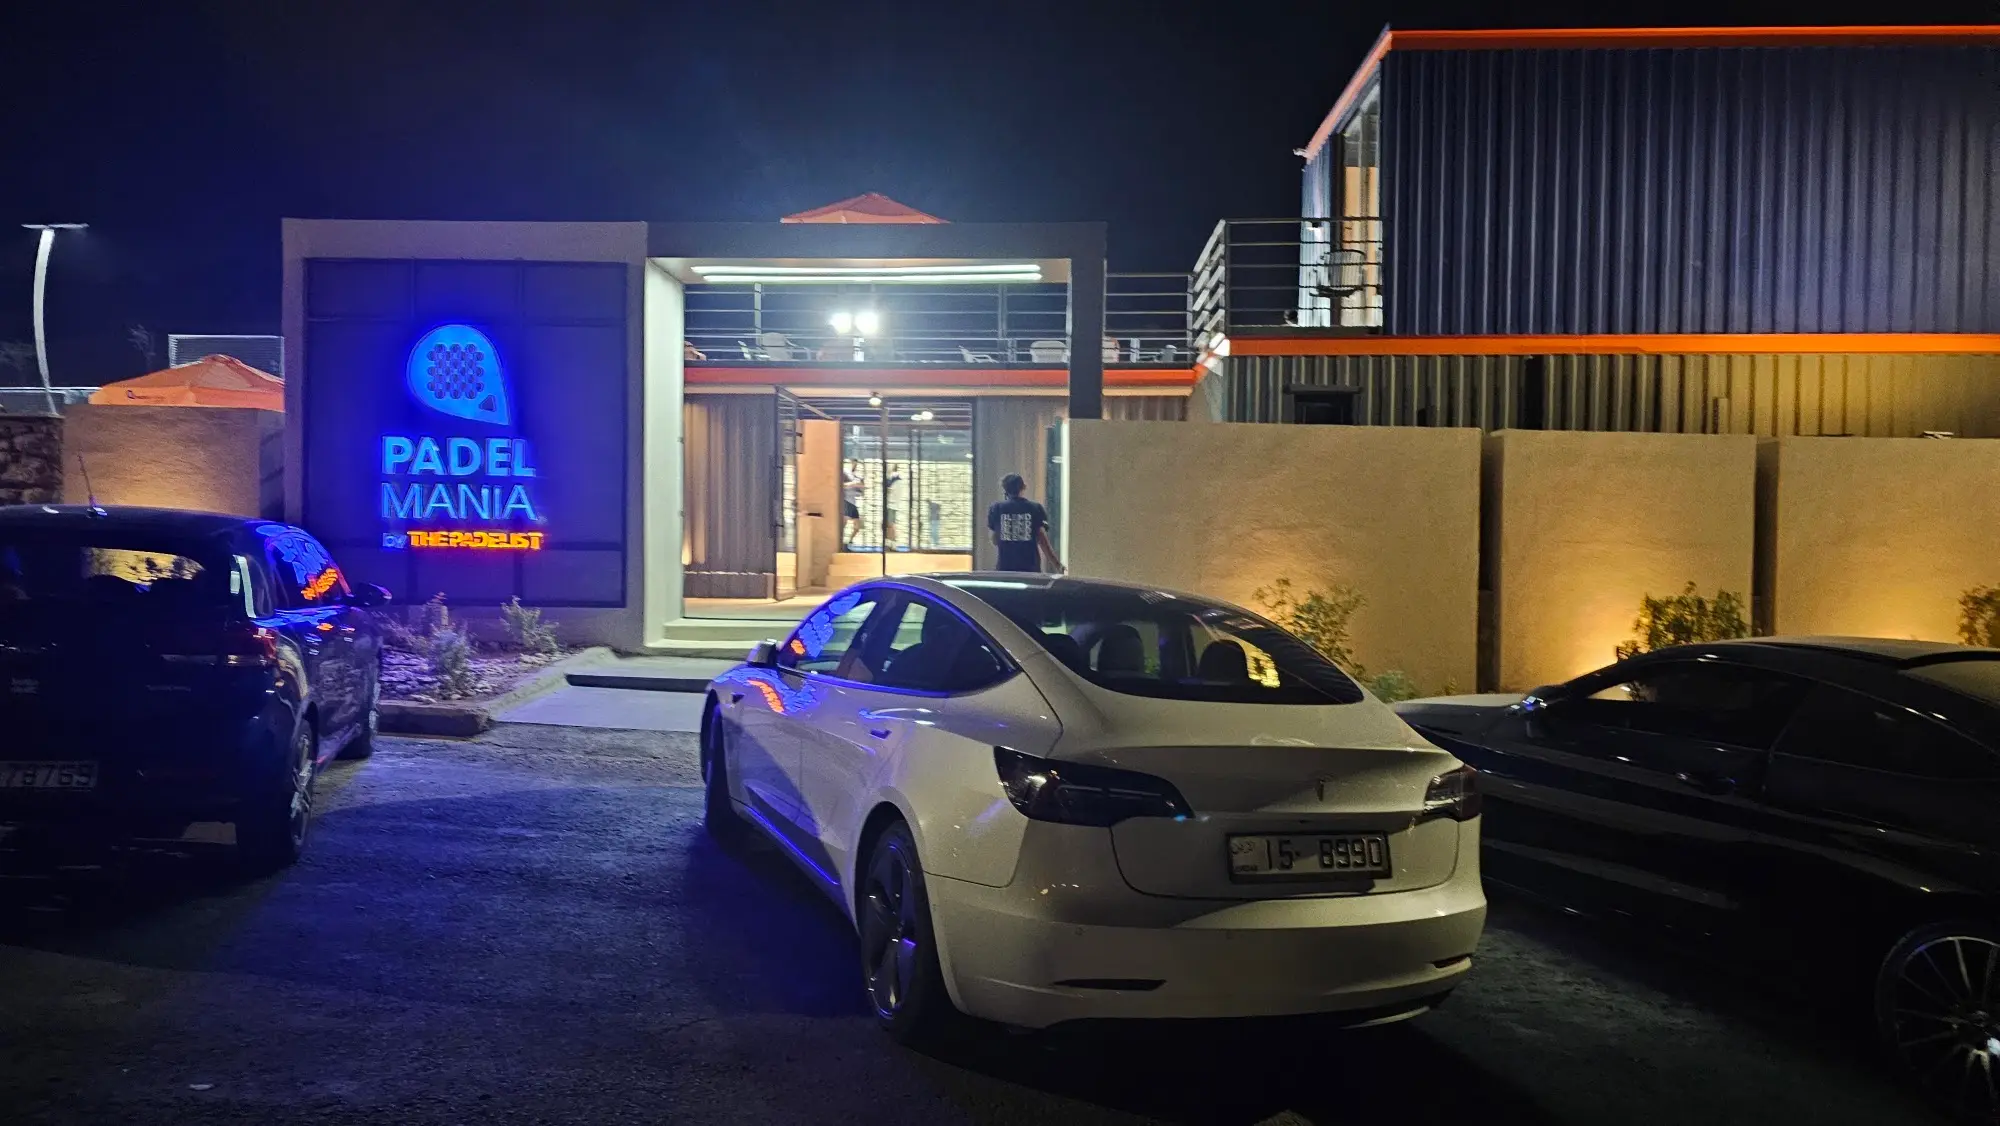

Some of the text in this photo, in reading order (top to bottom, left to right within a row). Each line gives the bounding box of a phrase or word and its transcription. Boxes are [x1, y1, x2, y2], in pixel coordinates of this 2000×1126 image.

[382, 436, 536, 477] PADEL
[381, 483, 539, 520] MANIA
[1318, 838, 1383, 868] 8990
